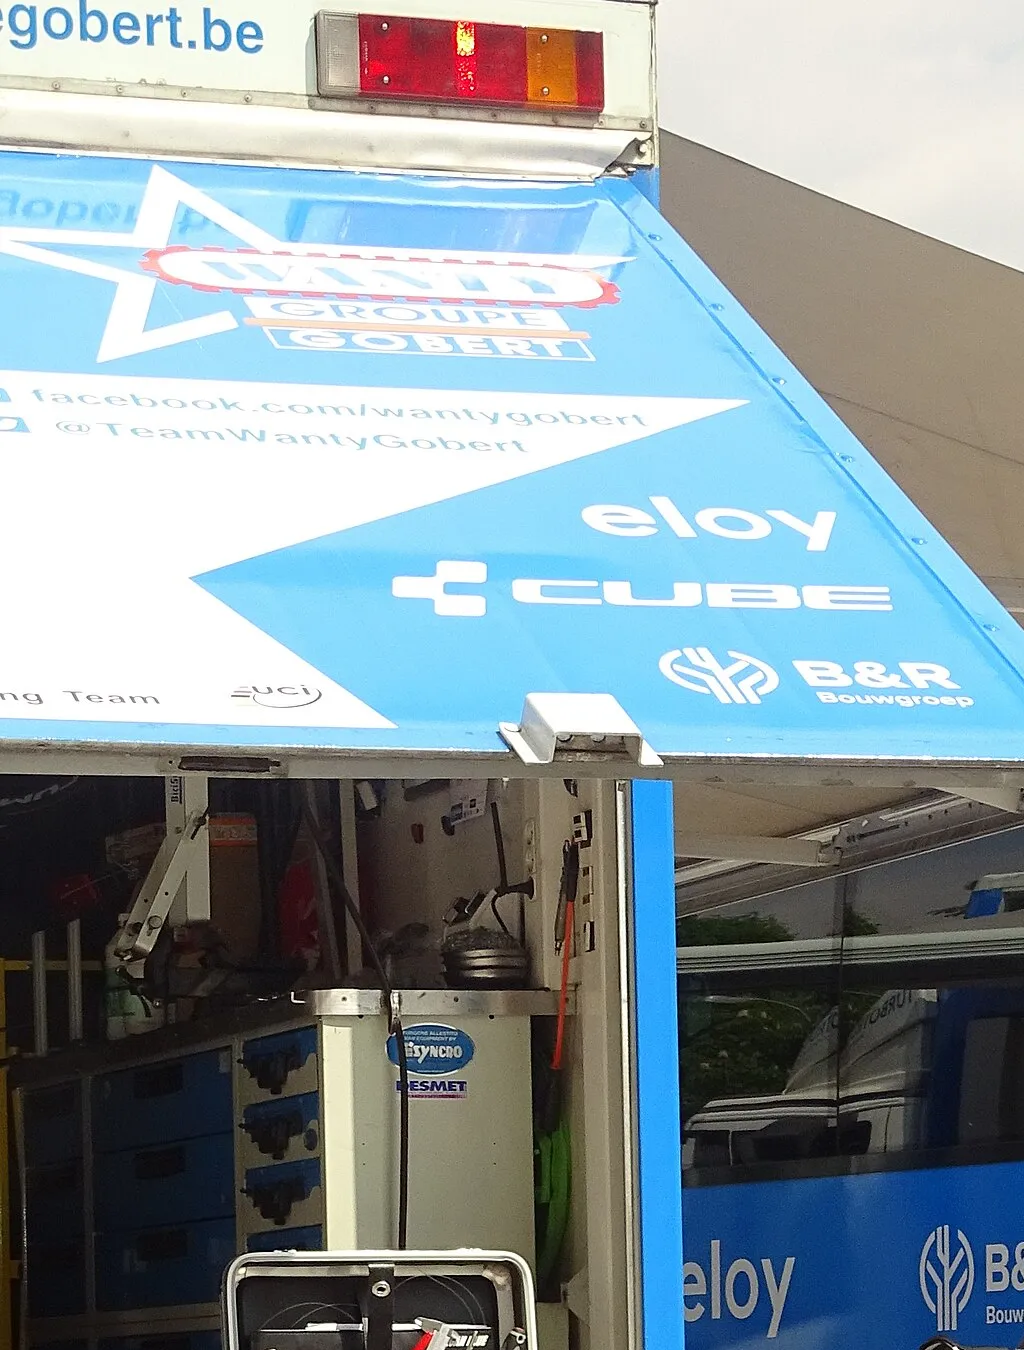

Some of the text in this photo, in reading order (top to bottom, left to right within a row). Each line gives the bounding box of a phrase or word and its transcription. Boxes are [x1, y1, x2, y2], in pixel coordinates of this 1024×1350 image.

[0, 0, 264, 54] gobert.be
[270, 302, 548, 327] GROUPE
[288, 330, 567, 357] GOBERT
[32, 388, 649, 427] facebook.com/wantygobert
[56, 420, 528, 453] @TeamWantyGobert
[581, 496, 837, 551] eloy
[512, 578, 893, 611] CUBE
[792, 659, 962, 690] B&R
[62, 690, 160, 705] Team
[816, 691, 975, 708] Bouwgroep
[683, 1240, 796, 1338] eloy
